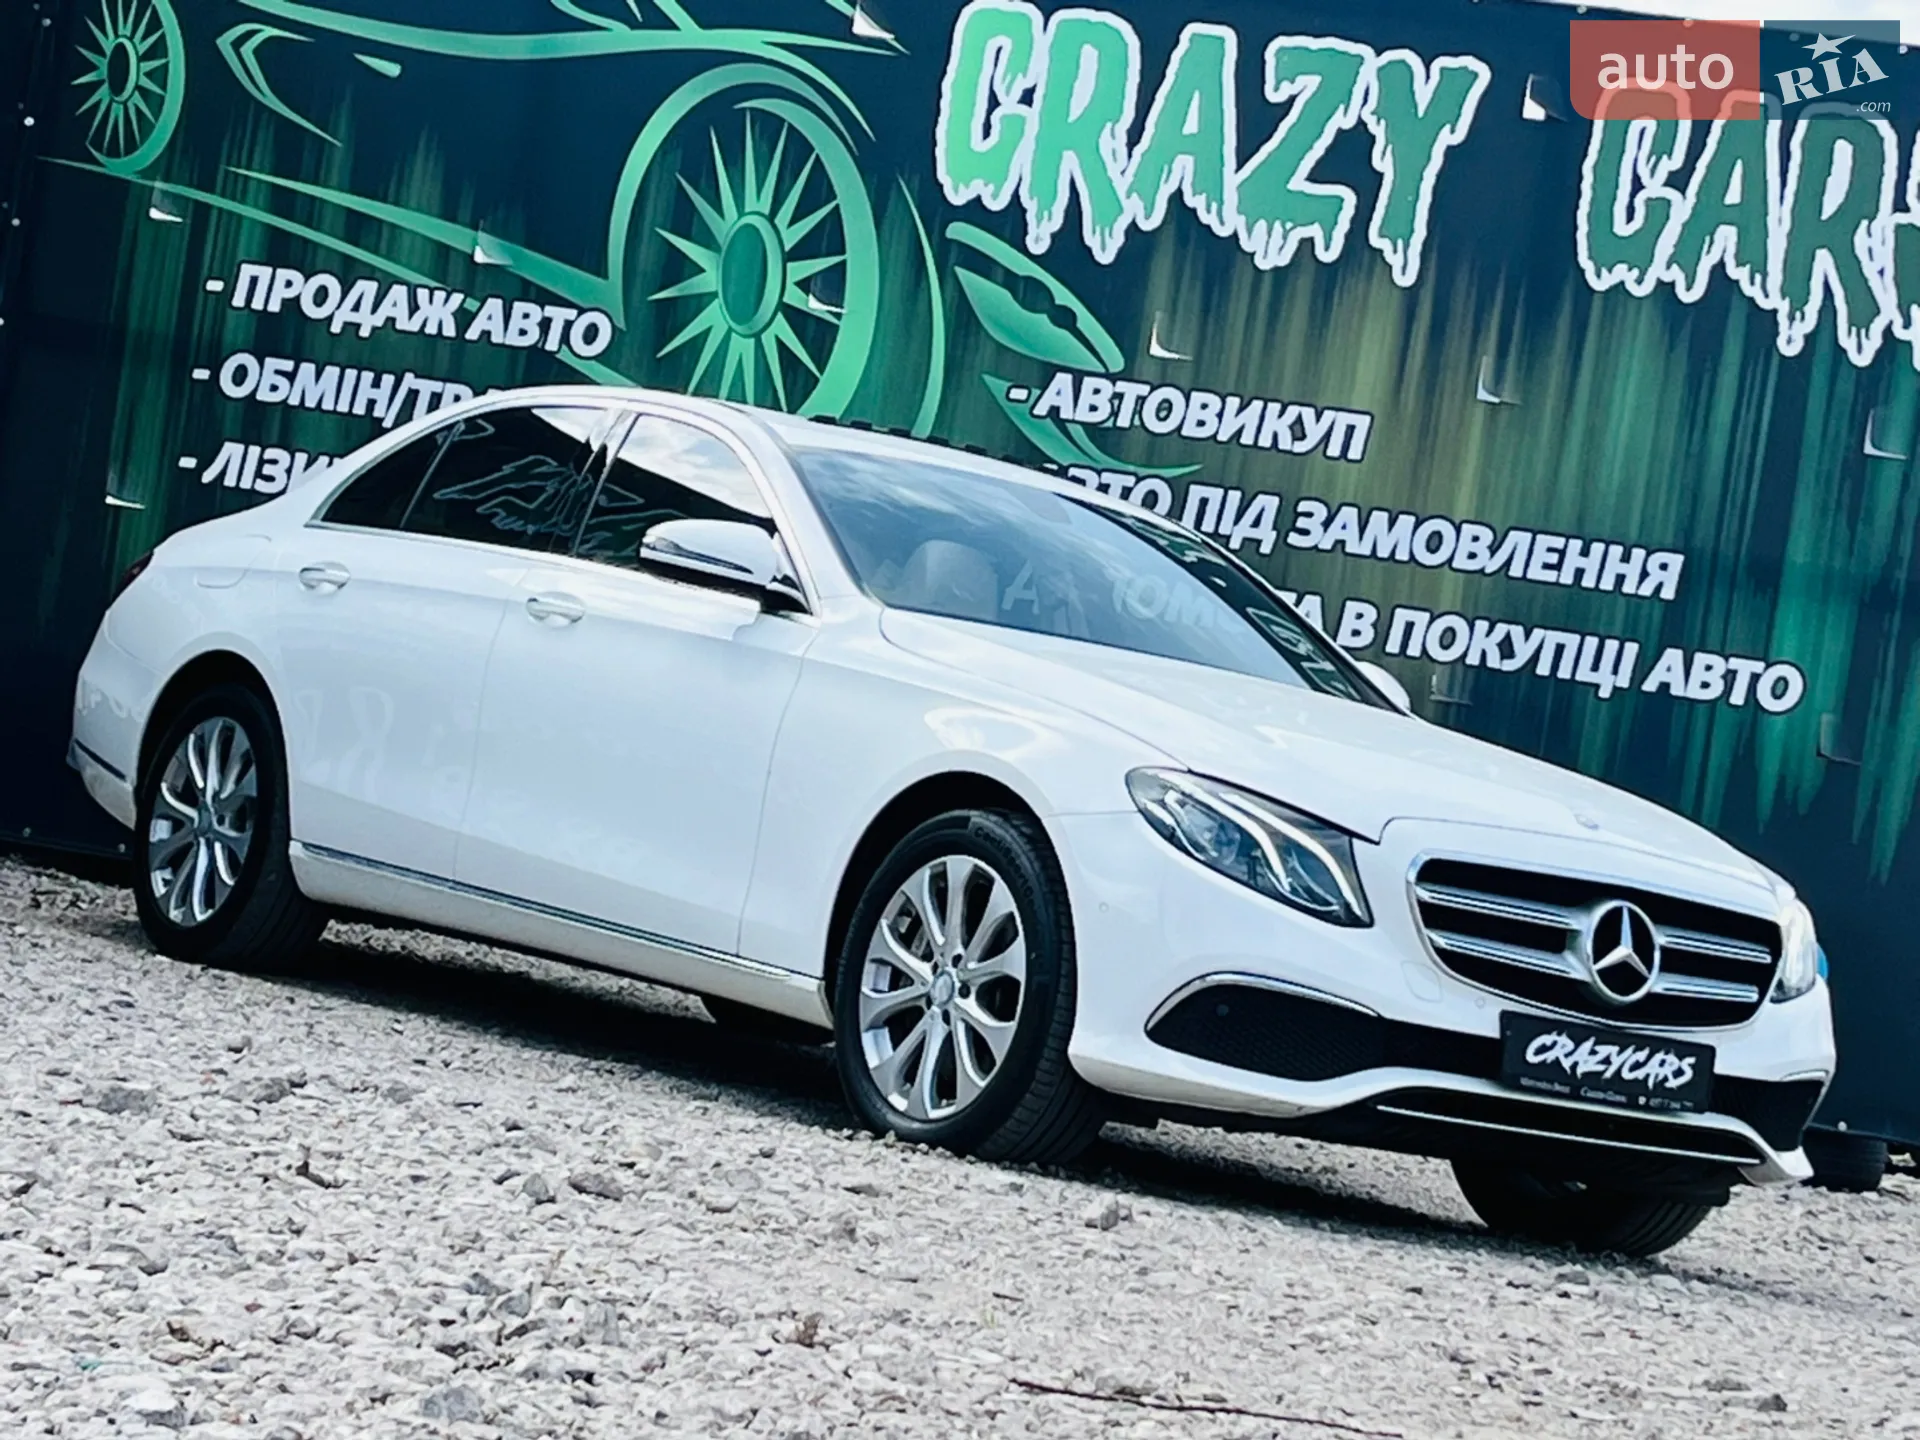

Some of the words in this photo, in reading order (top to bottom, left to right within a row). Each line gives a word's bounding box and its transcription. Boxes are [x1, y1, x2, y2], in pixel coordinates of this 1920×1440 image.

[936, 0, 1491, 288] CRAZY
[231, 262, 464, 338] ПРОДАЖ
[465, 299, 612, 357] АВТО
[1032, 373, 1372, 462] АВТОВИКУП
[201, 441, 342, 494] ЛІЗИ
[1181, 484, 1280, 555] ПІД
[1288, 500, 1684, 600] ЗАМОВЛЕННЯ
[1336, 600, 1377, 648] В
[1385, 607, 1639, 699] ПОКУПЦІ
[1641, 649, 1805, 713] АВТО
[1525, 1030, 1696, 1090] CRAZYCARS
